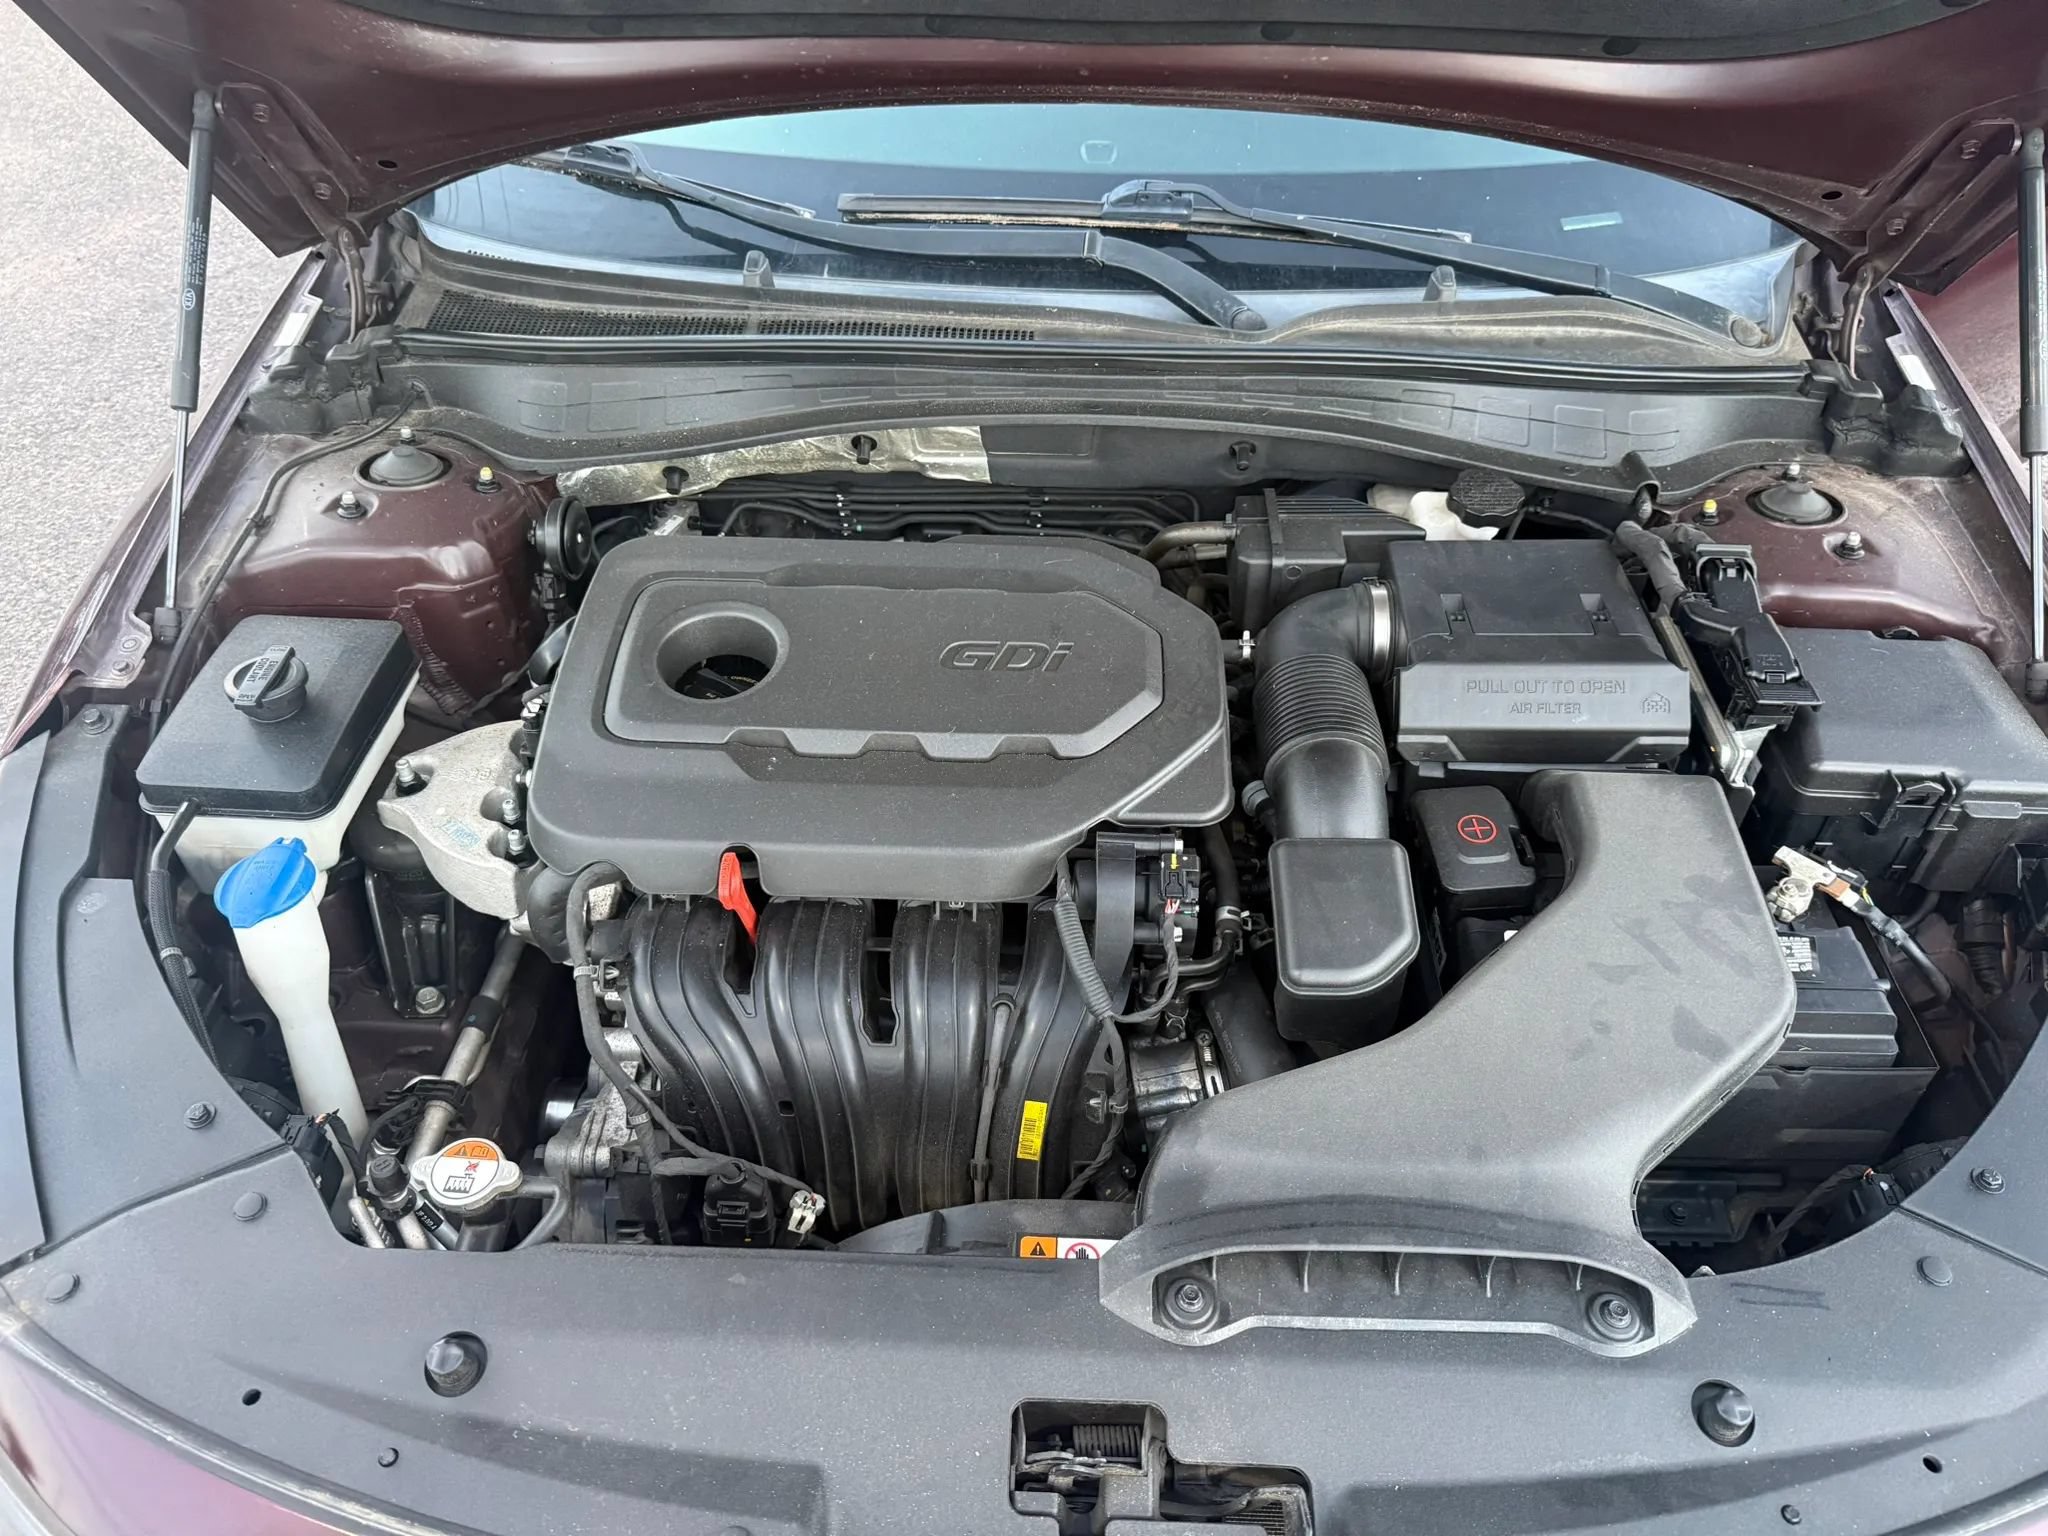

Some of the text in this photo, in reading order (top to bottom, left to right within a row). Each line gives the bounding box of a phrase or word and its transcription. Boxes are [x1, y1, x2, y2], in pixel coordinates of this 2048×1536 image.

[183, 289, 194, 309] KIA
[939, 640, 1075, 672] GDi
[246, 657, 270, 682] COOLANT
[257, 660, 279, 681] ENGINE
[1466, 680, 1626, 694] PULL OUT TO OPEN
[1510, 702, 1582, 714] AIR FILTER
